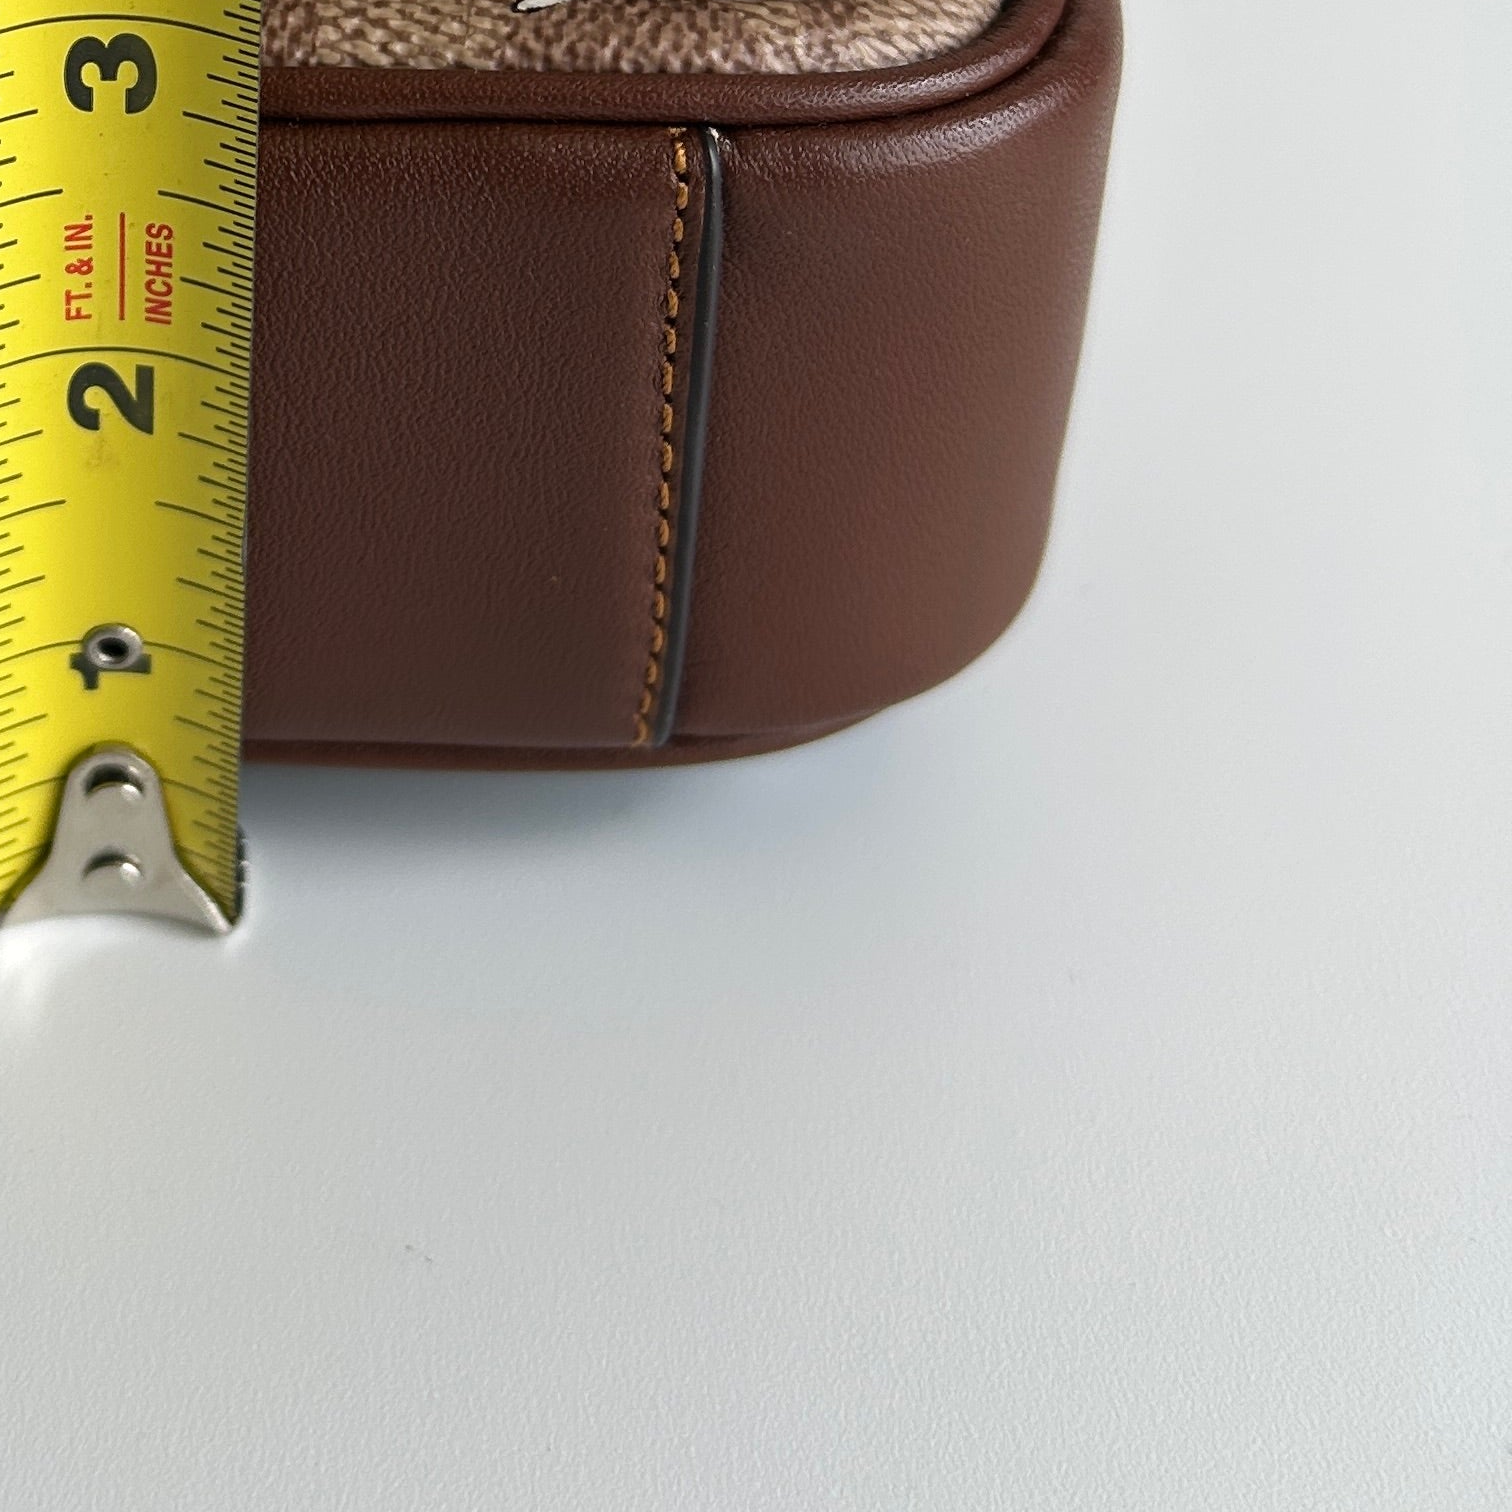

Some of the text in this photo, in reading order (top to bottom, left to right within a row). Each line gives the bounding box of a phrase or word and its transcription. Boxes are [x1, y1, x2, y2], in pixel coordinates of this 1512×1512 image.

[63, 33, 159, 116] 3
[64, 214, 94, 322] FT. & IN.
[144, 222, 174, 326] INCHES
[67, 361, 155, 436] 2
